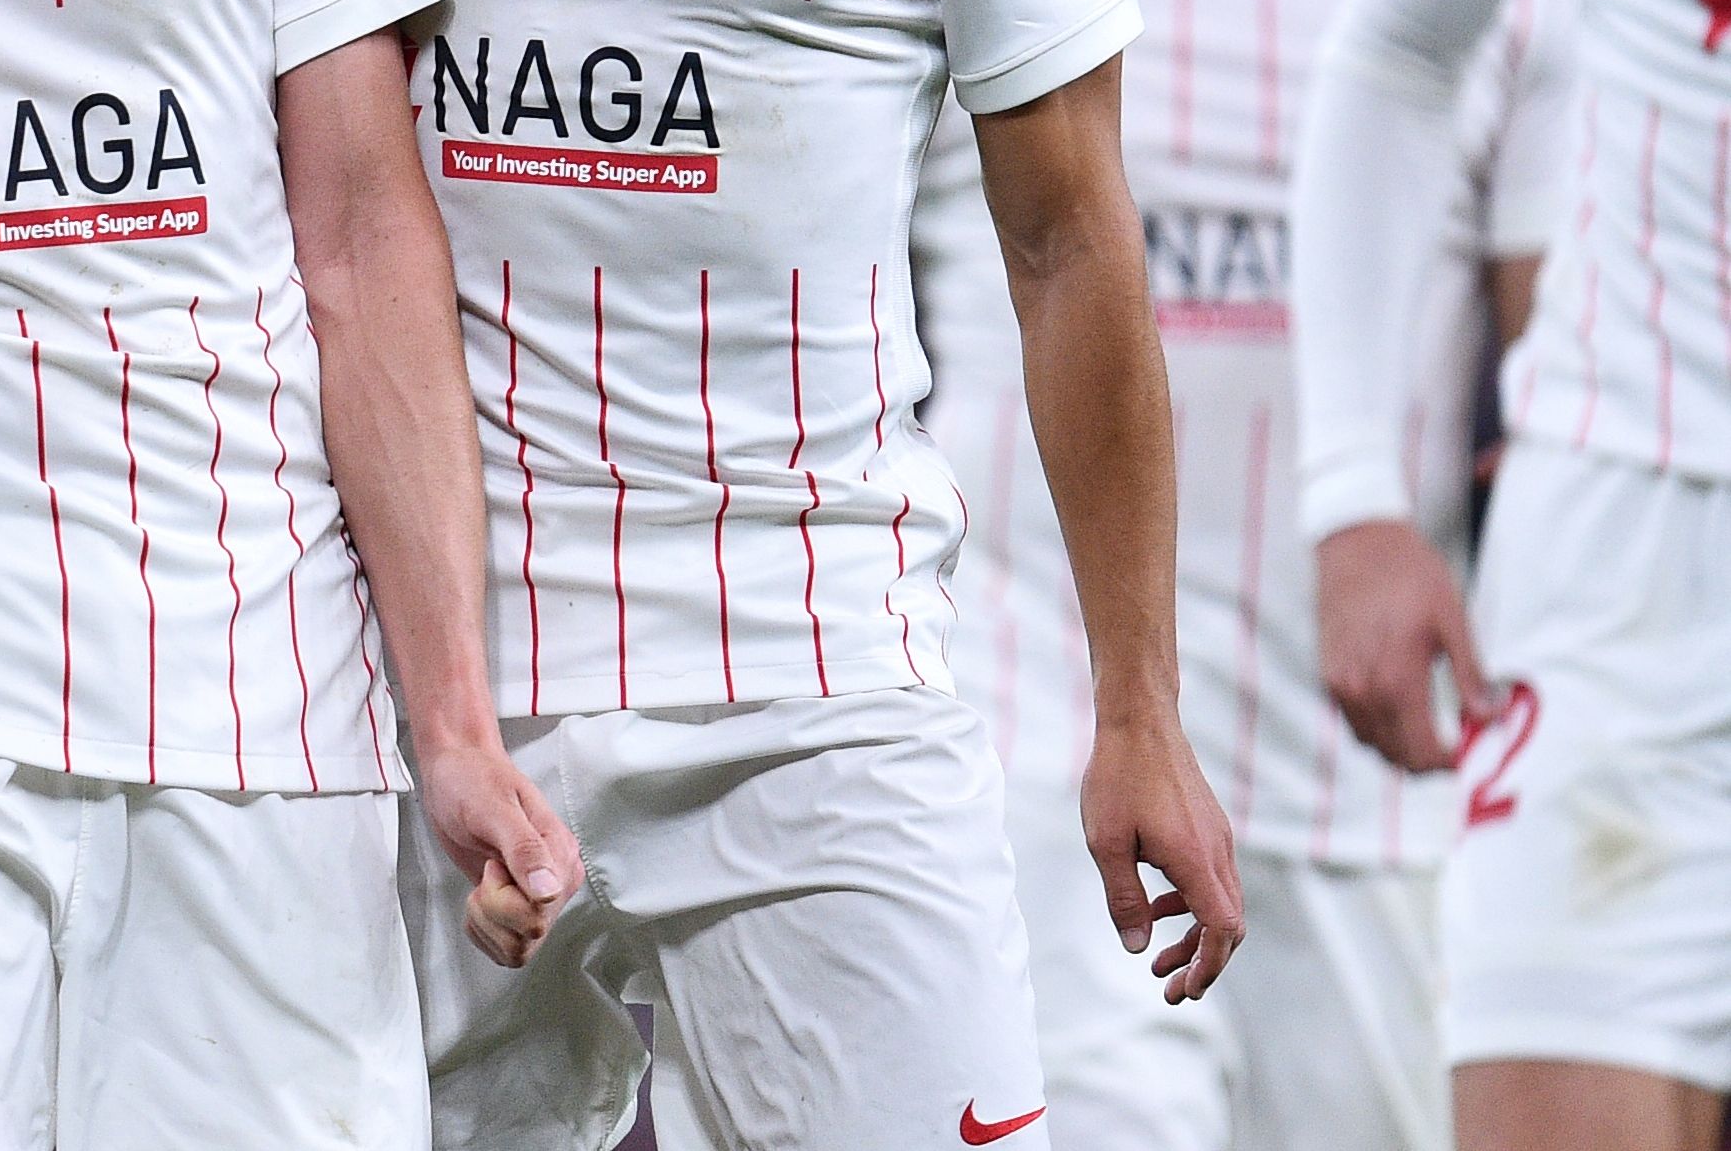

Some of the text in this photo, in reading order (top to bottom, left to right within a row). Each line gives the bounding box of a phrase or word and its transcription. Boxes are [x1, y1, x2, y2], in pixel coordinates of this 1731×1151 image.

[432, 34, 721, 148] NAGA
[451, 150, 707, 189] Your Investing Super App
[0, 214, 96, 242] Investing
[96, 211, 157, 239] Super
[157, 207, 201, 233] App
